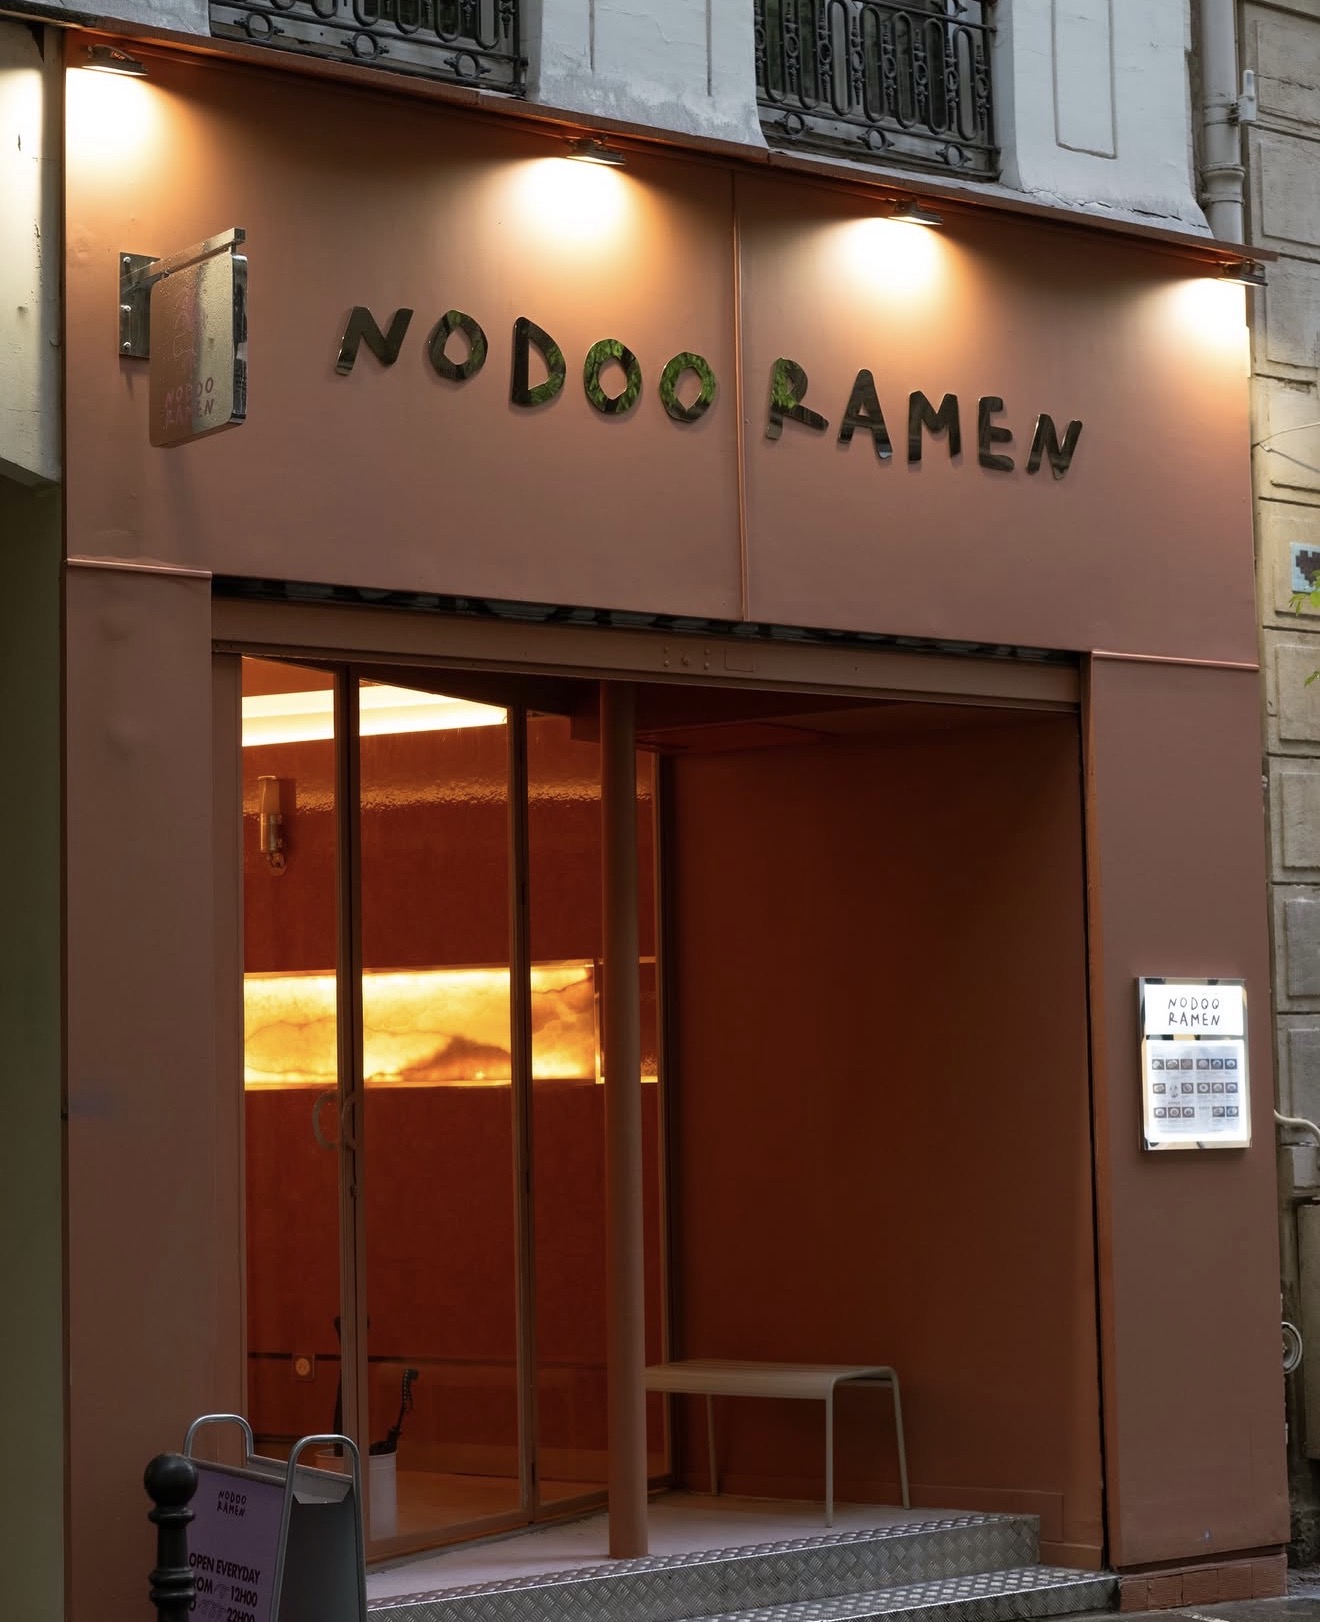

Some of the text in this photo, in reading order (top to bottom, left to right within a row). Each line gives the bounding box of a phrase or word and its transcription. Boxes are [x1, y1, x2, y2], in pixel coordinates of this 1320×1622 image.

[335, 306, 1083, 480] NODOO RAMEN
[1168, 997, 1220, 1010] NODOO
[1168, 1012, 1220, 1026] RAMEN
[218, 1490, 247, 1505] NODOO
[216, 1500, 246, 1517] RAMEN
[189, 1552, 260, 1586] OPEN EVERYDAY
[231, 1585, 258, 1608] 12H00
